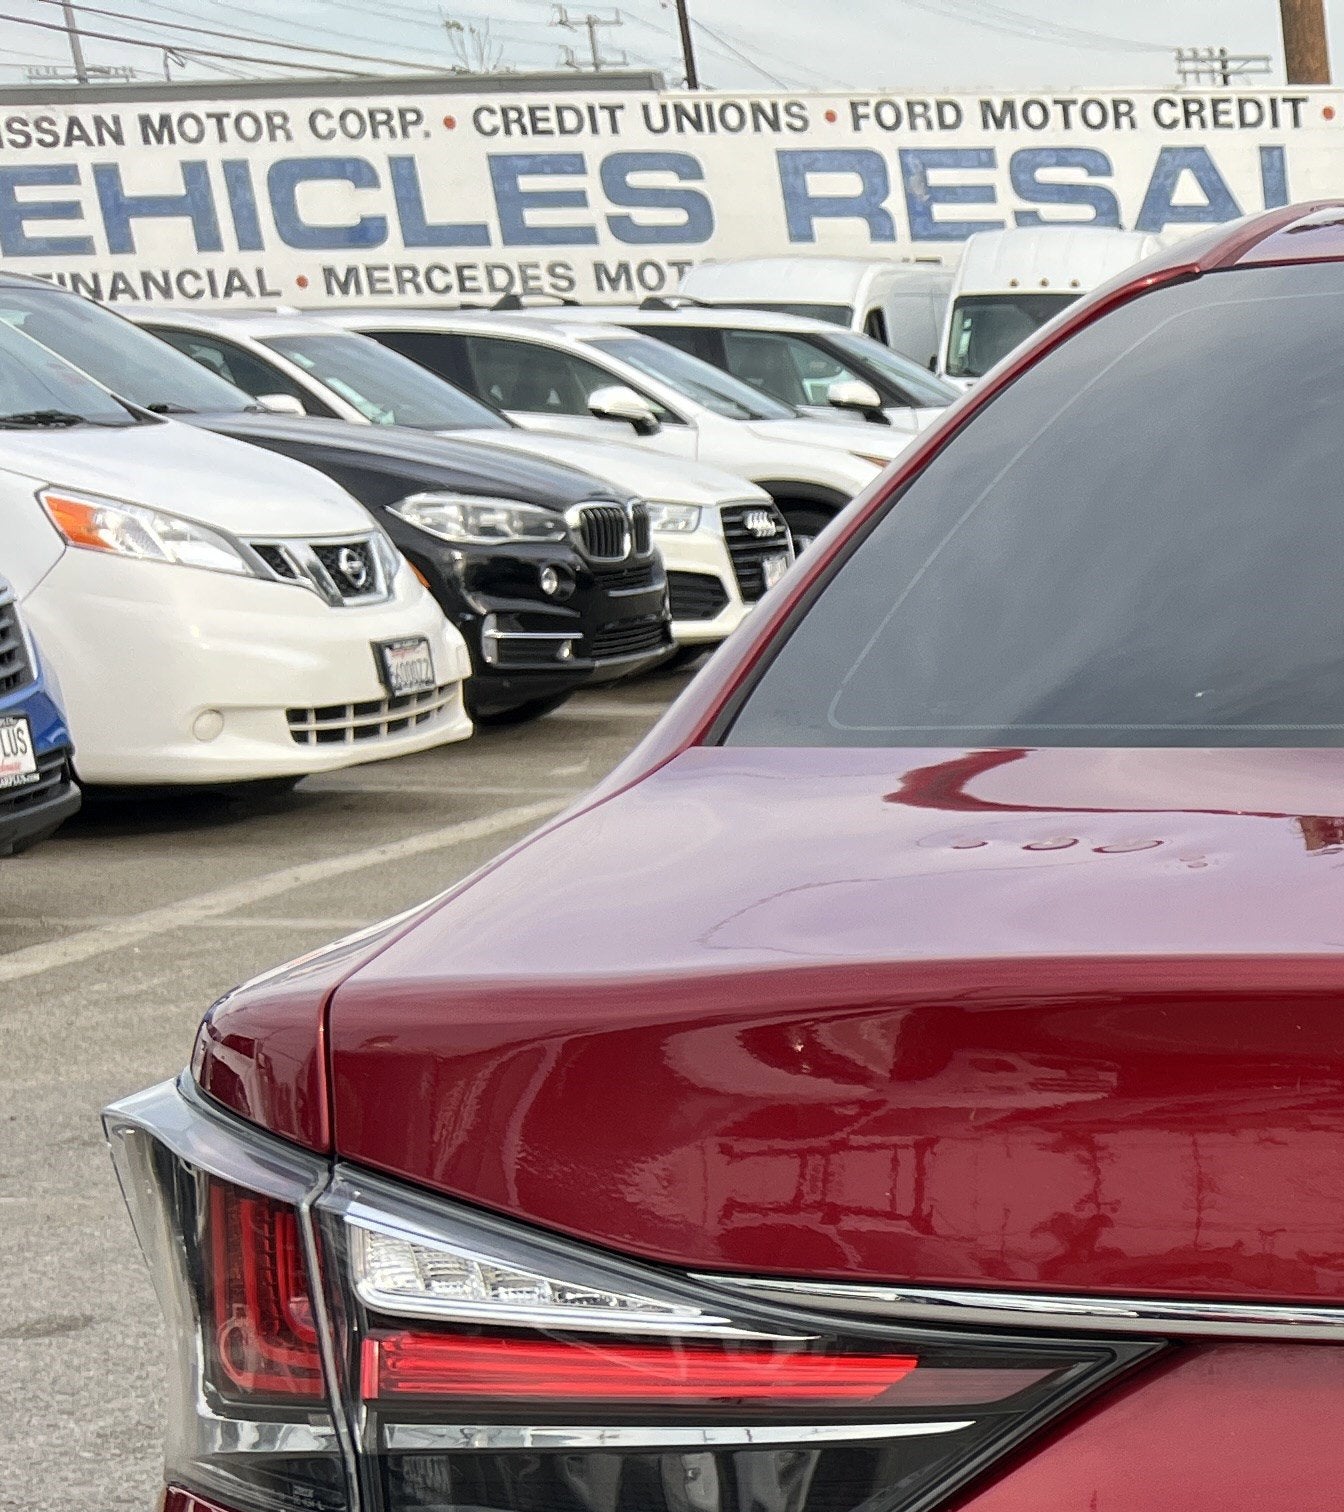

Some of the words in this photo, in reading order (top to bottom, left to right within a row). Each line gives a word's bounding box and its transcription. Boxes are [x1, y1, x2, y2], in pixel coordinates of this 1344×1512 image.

[138, 110, 293, 146] MOTOR
[309, 107, 431, 141] CORP.
[473, 103, 625, 137] CREDIT
[642, 101, 809, 135] UNIONS
[850, 99, 963, 132] FORD
[980, 98, 1137, 131] MOTOR
[1153, 97, 1308, 130] CREDIT
[323, 259, 576, 299] MERCEDES
